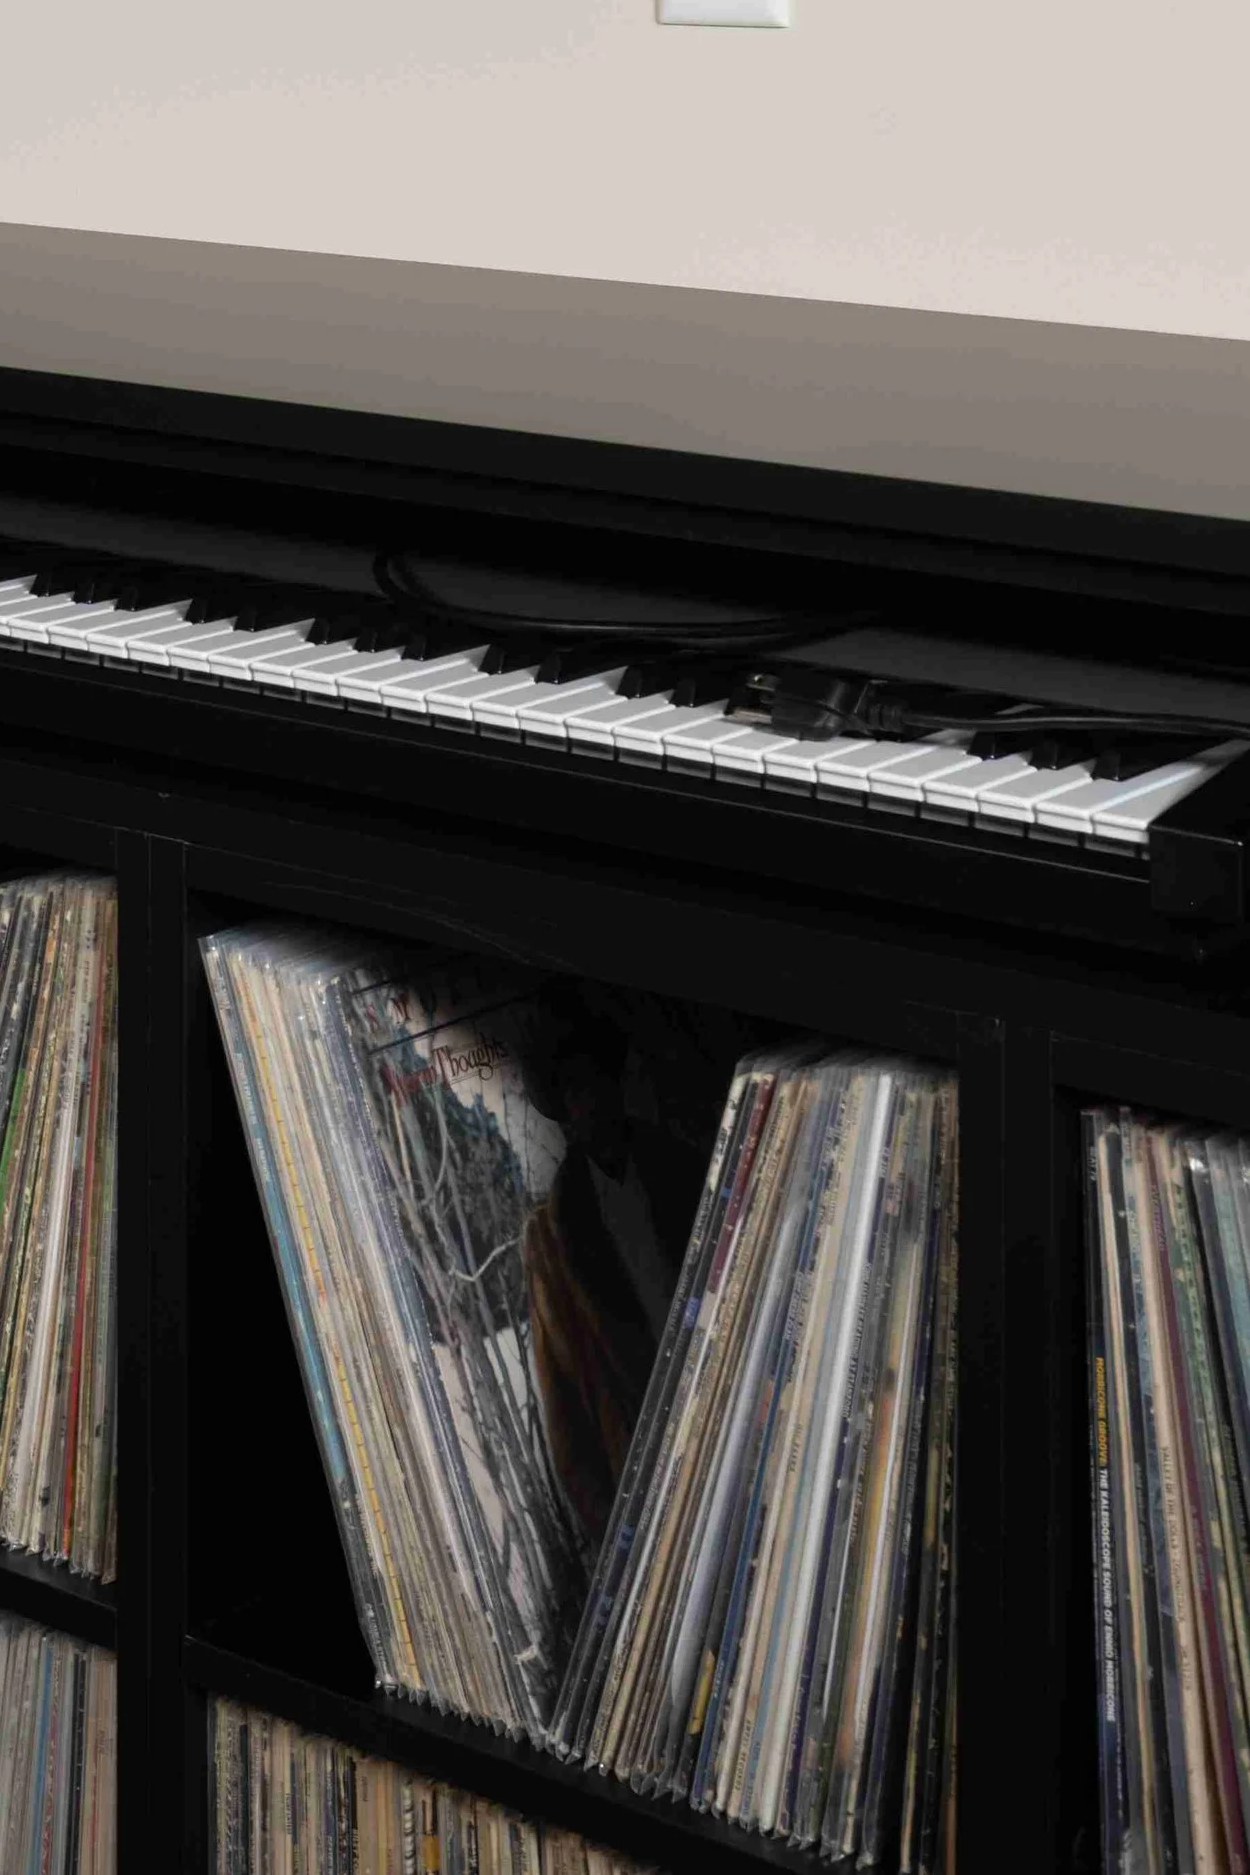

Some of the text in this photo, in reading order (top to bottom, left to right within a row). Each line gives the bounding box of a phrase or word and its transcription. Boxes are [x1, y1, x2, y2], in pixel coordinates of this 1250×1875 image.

[432, 1032, 509, 1086] Thoughts
[1095, 1356, 1106, 1419] MORRICONE
[1098, 1468, 1110, 1490] THE
[1099, 1490, 1111, 1567] KALEIDOSCOPE
[1101, 1570, 1112, 1607] SOUND
[1103, 1609, 1112, 1623] OF
[1103, 1624, 1113, 1658] ENNIO
[1104, 1659, 1116, 1722] MORRICONE
